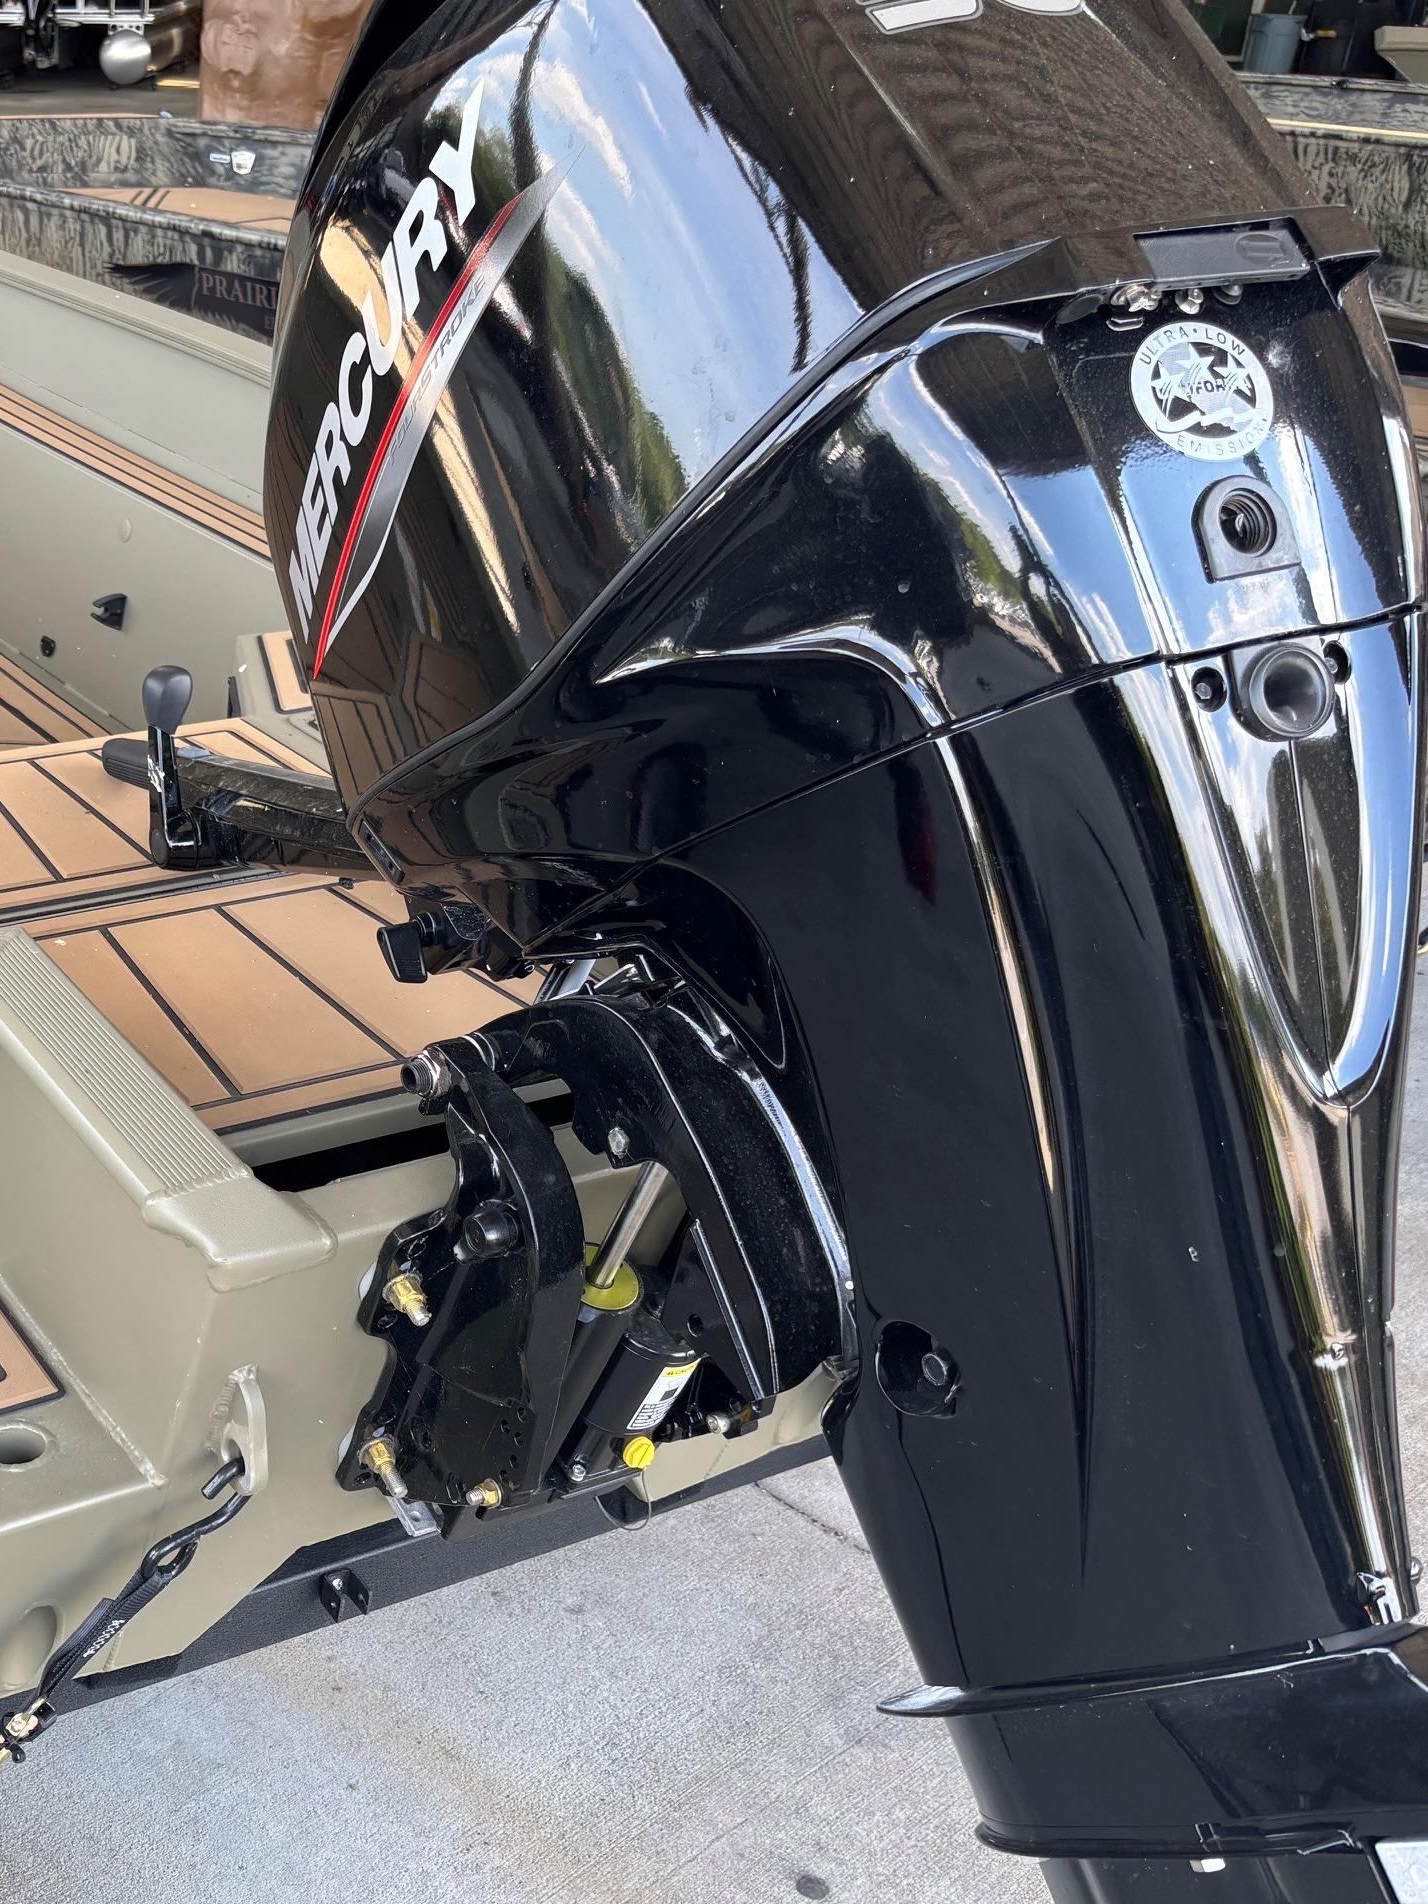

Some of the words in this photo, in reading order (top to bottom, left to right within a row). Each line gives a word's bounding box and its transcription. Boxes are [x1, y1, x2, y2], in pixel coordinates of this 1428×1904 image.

[201, 272, 277, 310] PRAIRI
[289, 77, 483, 644] MERCURY
[1139, 326, 1189, 365] ULTRA
[1205, 327, 1246, 356] LOW
